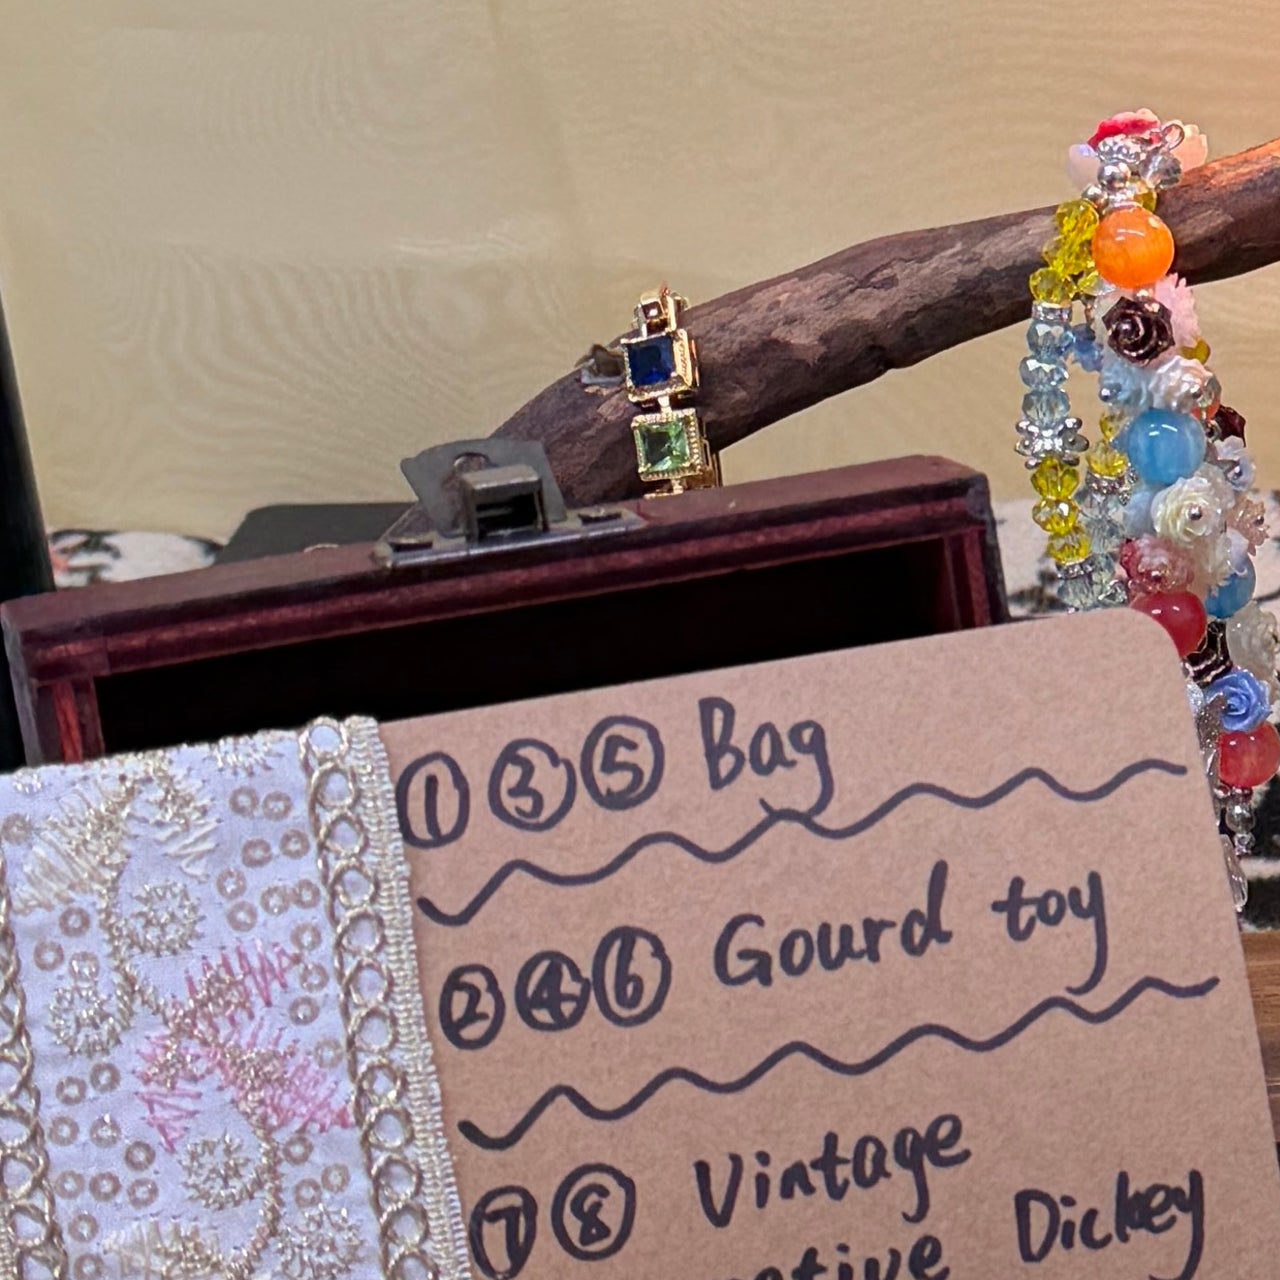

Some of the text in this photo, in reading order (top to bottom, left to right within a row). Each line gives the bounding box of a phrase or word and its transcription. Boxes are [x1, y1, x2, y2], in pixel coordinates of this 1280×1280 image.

[699, 697, 834, 818] Bag
[715, 861, 953, 987] Gourd
[992, 872, 1108, 995] toy
[694, 1115, 971, 1224] Vintage
